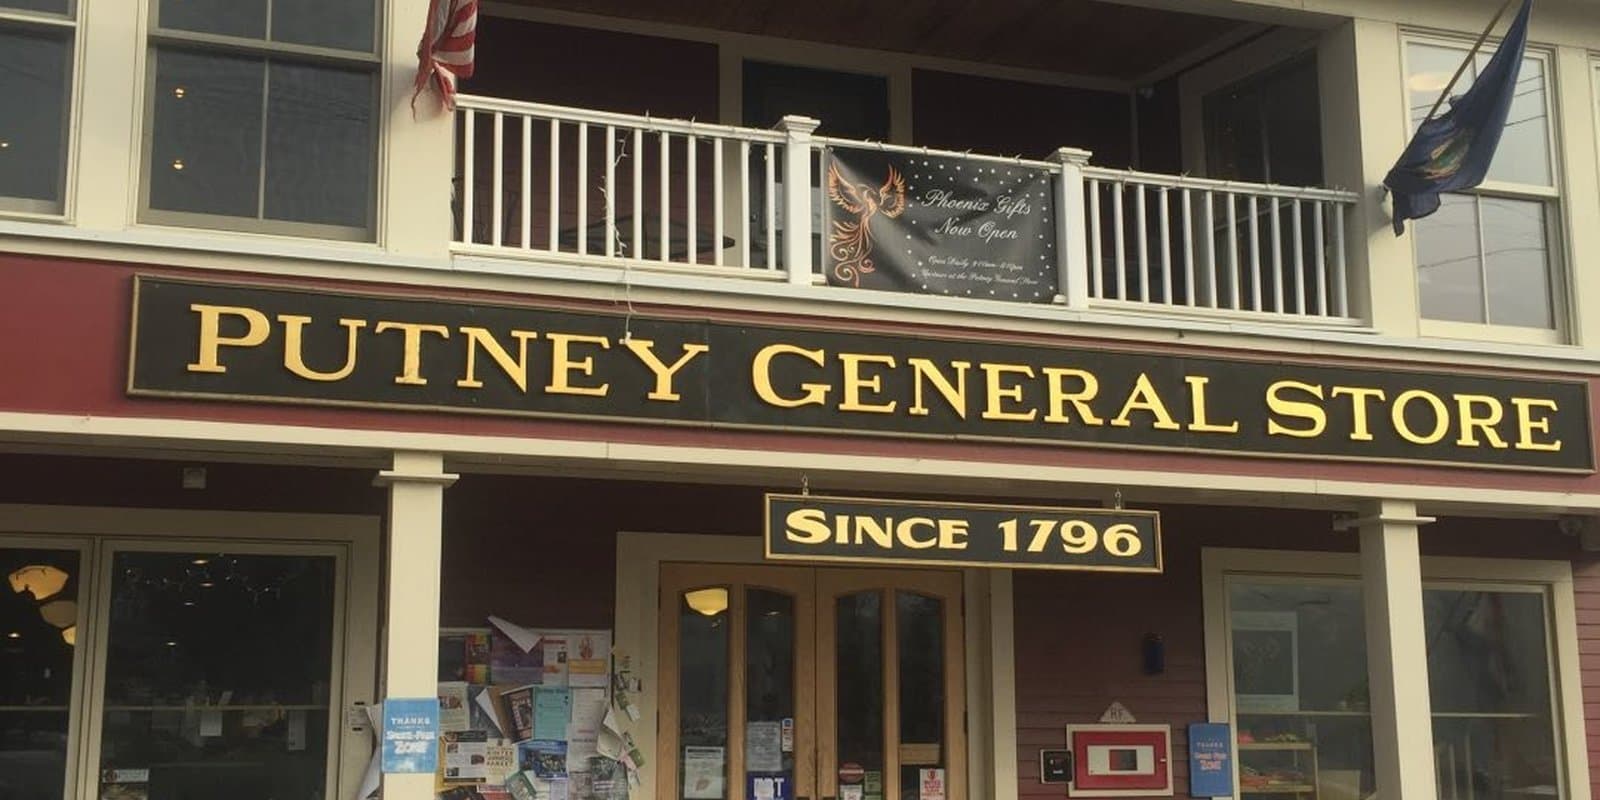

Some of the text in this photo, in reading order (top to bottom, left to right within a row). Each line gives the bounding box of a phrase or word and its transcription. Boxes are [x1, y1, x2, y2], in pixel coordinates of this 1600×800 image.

[920, 188, 1031, 220] Phoenix Gifts
[934, 216, 1018, 244] Now Open
[187, 303, 1562, 453] PUTNEY GENERAL STORE
[785, 508, 1142, 557] SINCE 1796
[390, 717, 431, 725] THANKS
